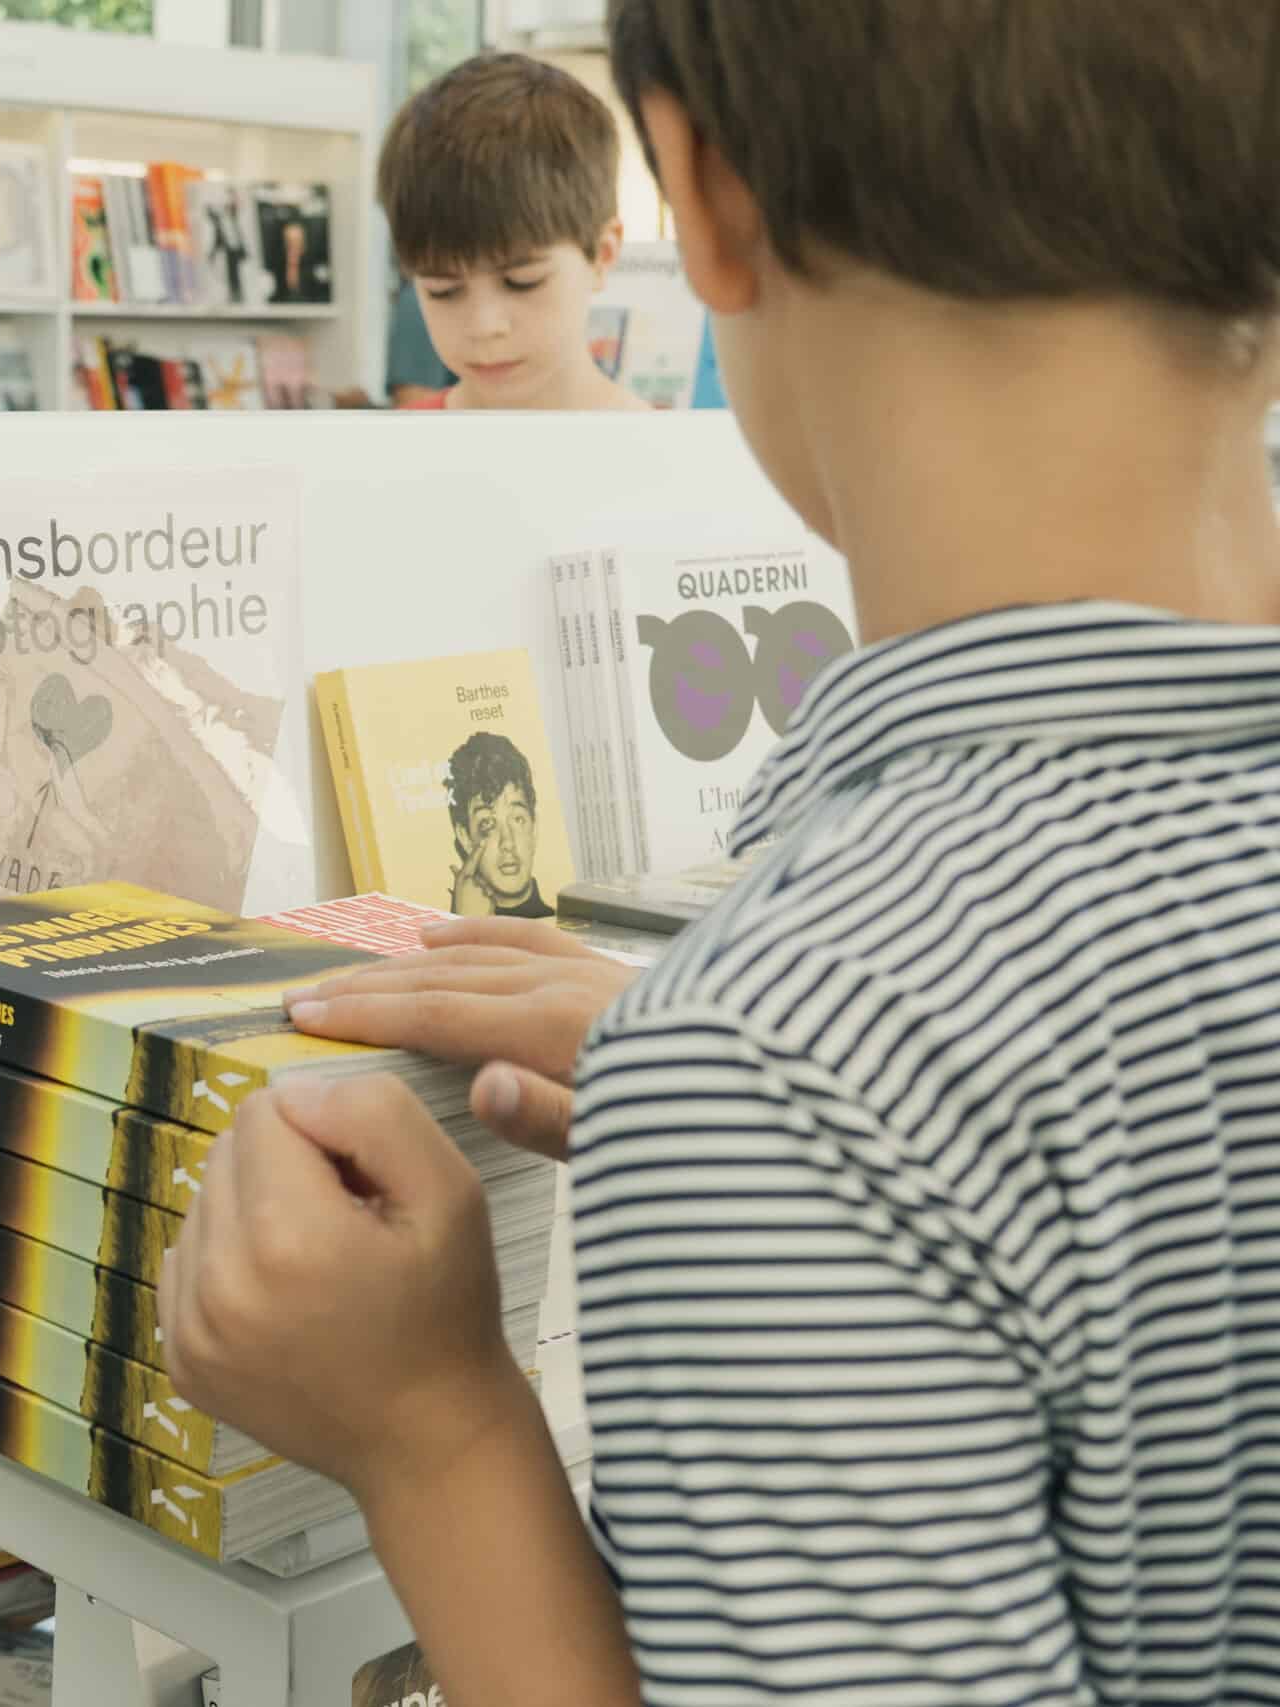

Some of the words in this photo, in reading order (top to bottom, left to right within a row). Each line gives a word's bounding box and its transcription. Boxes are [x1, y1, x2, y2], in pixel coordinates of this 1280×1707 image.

[677, 563, 809, 600] QUADERNI
[455, 682, 510, 704] Barthes
[469, 703, 505, 721] reset
